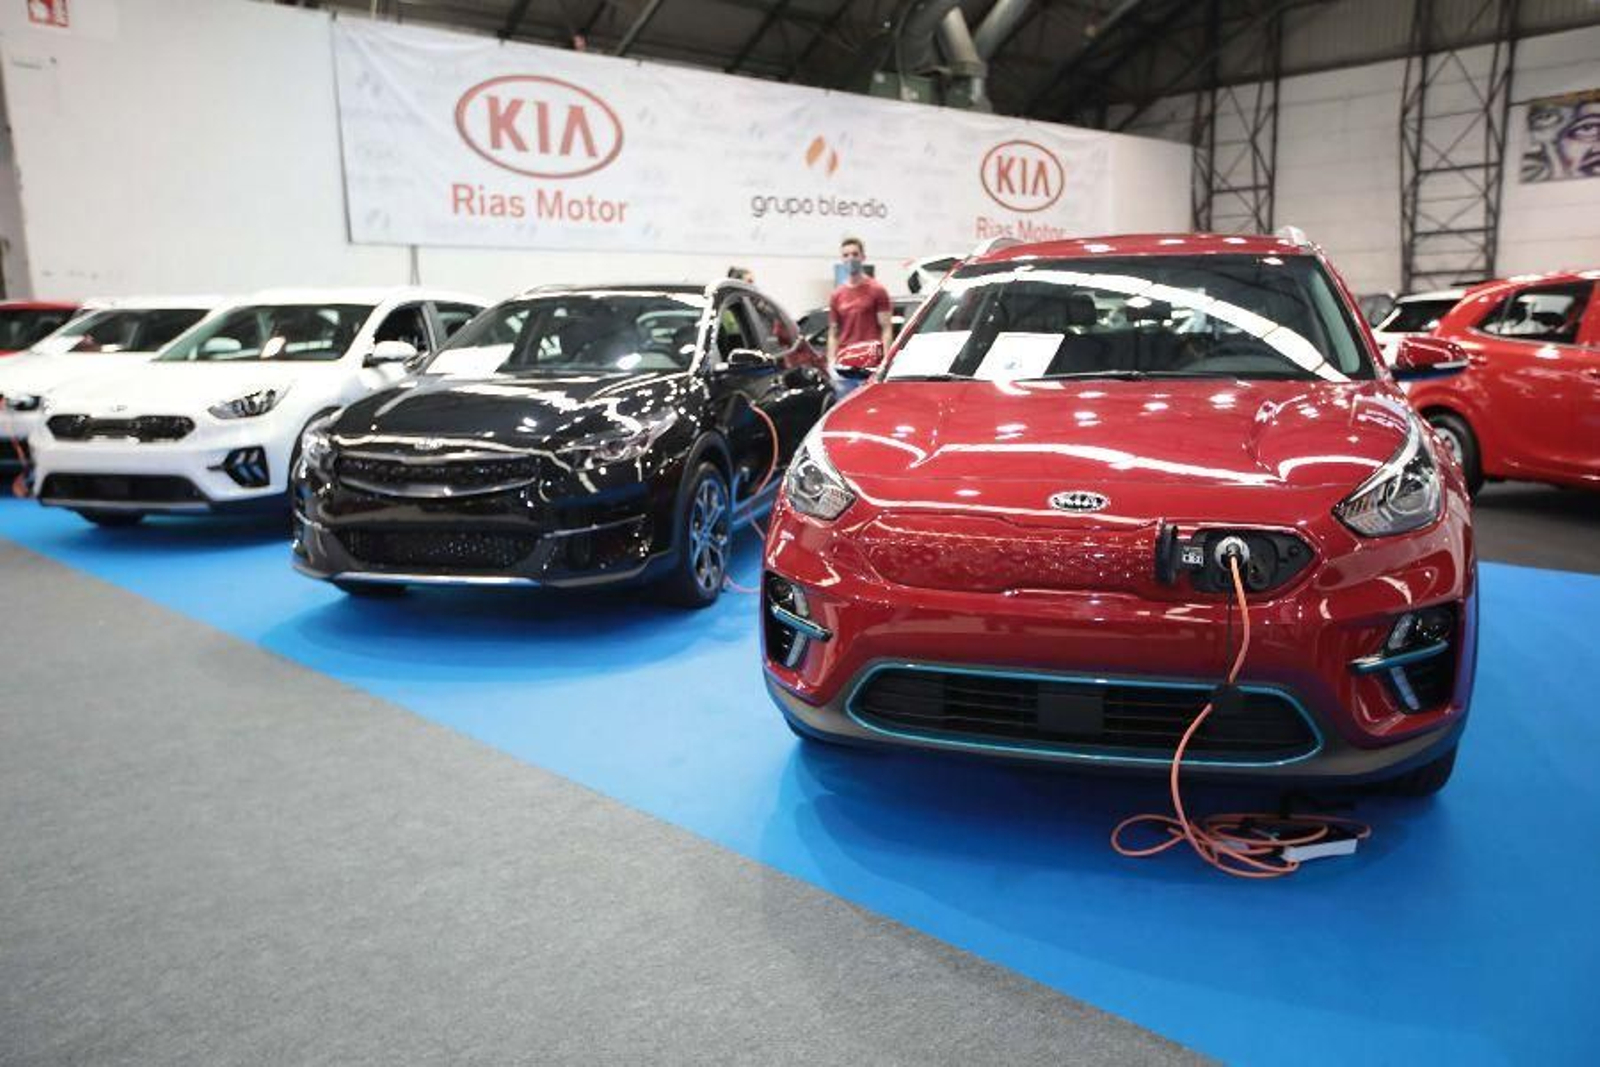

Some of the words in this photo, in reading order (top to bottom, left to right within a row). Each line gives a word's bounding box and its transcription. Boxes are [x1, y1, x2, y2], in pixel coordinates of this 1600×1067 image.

[487, 96, 597, 157] KIA
[996, 155, 1049, 197] KIA
[452, 184, 525, 218] Rias
[537, 188, 627, 222] Motor
[751, 196, 814, 218] grupo
